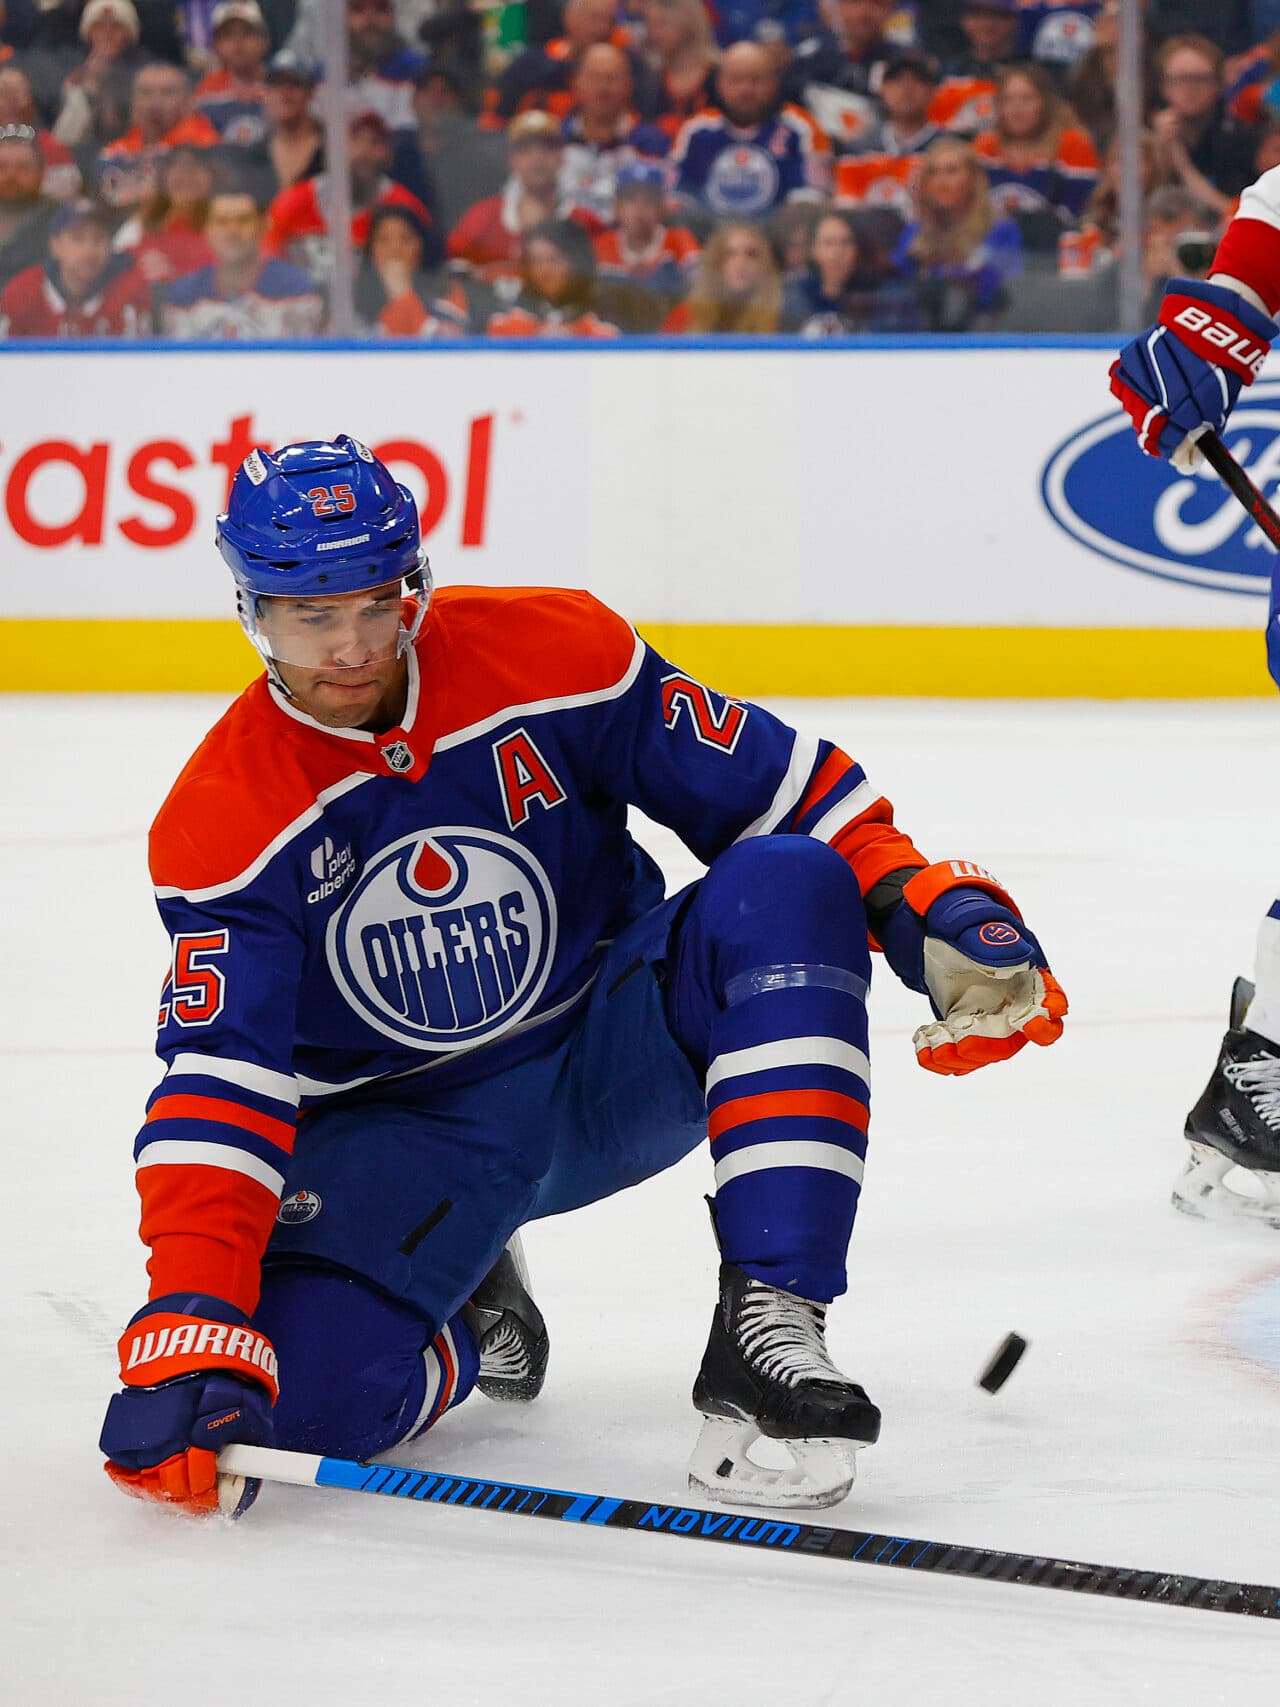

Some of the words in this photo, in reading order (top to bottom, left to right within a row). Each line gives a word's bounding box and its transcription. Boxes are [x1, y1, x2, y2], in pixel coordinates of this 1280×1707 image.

[307, 484, 357, 516] 25
[660, 671, 750, 755] 2
[492, 727, 568, 831] A
[307, 858, 356, 904] alberta
[157, 928, 230, 1028] 5
[360, 890, 531, 1030] OILERS
[127, 1324, 279, 1395] WARRIO
[207, 1409, 241, 1430] COVERT
[638, 1504, 800, 1548] NOVIUM
